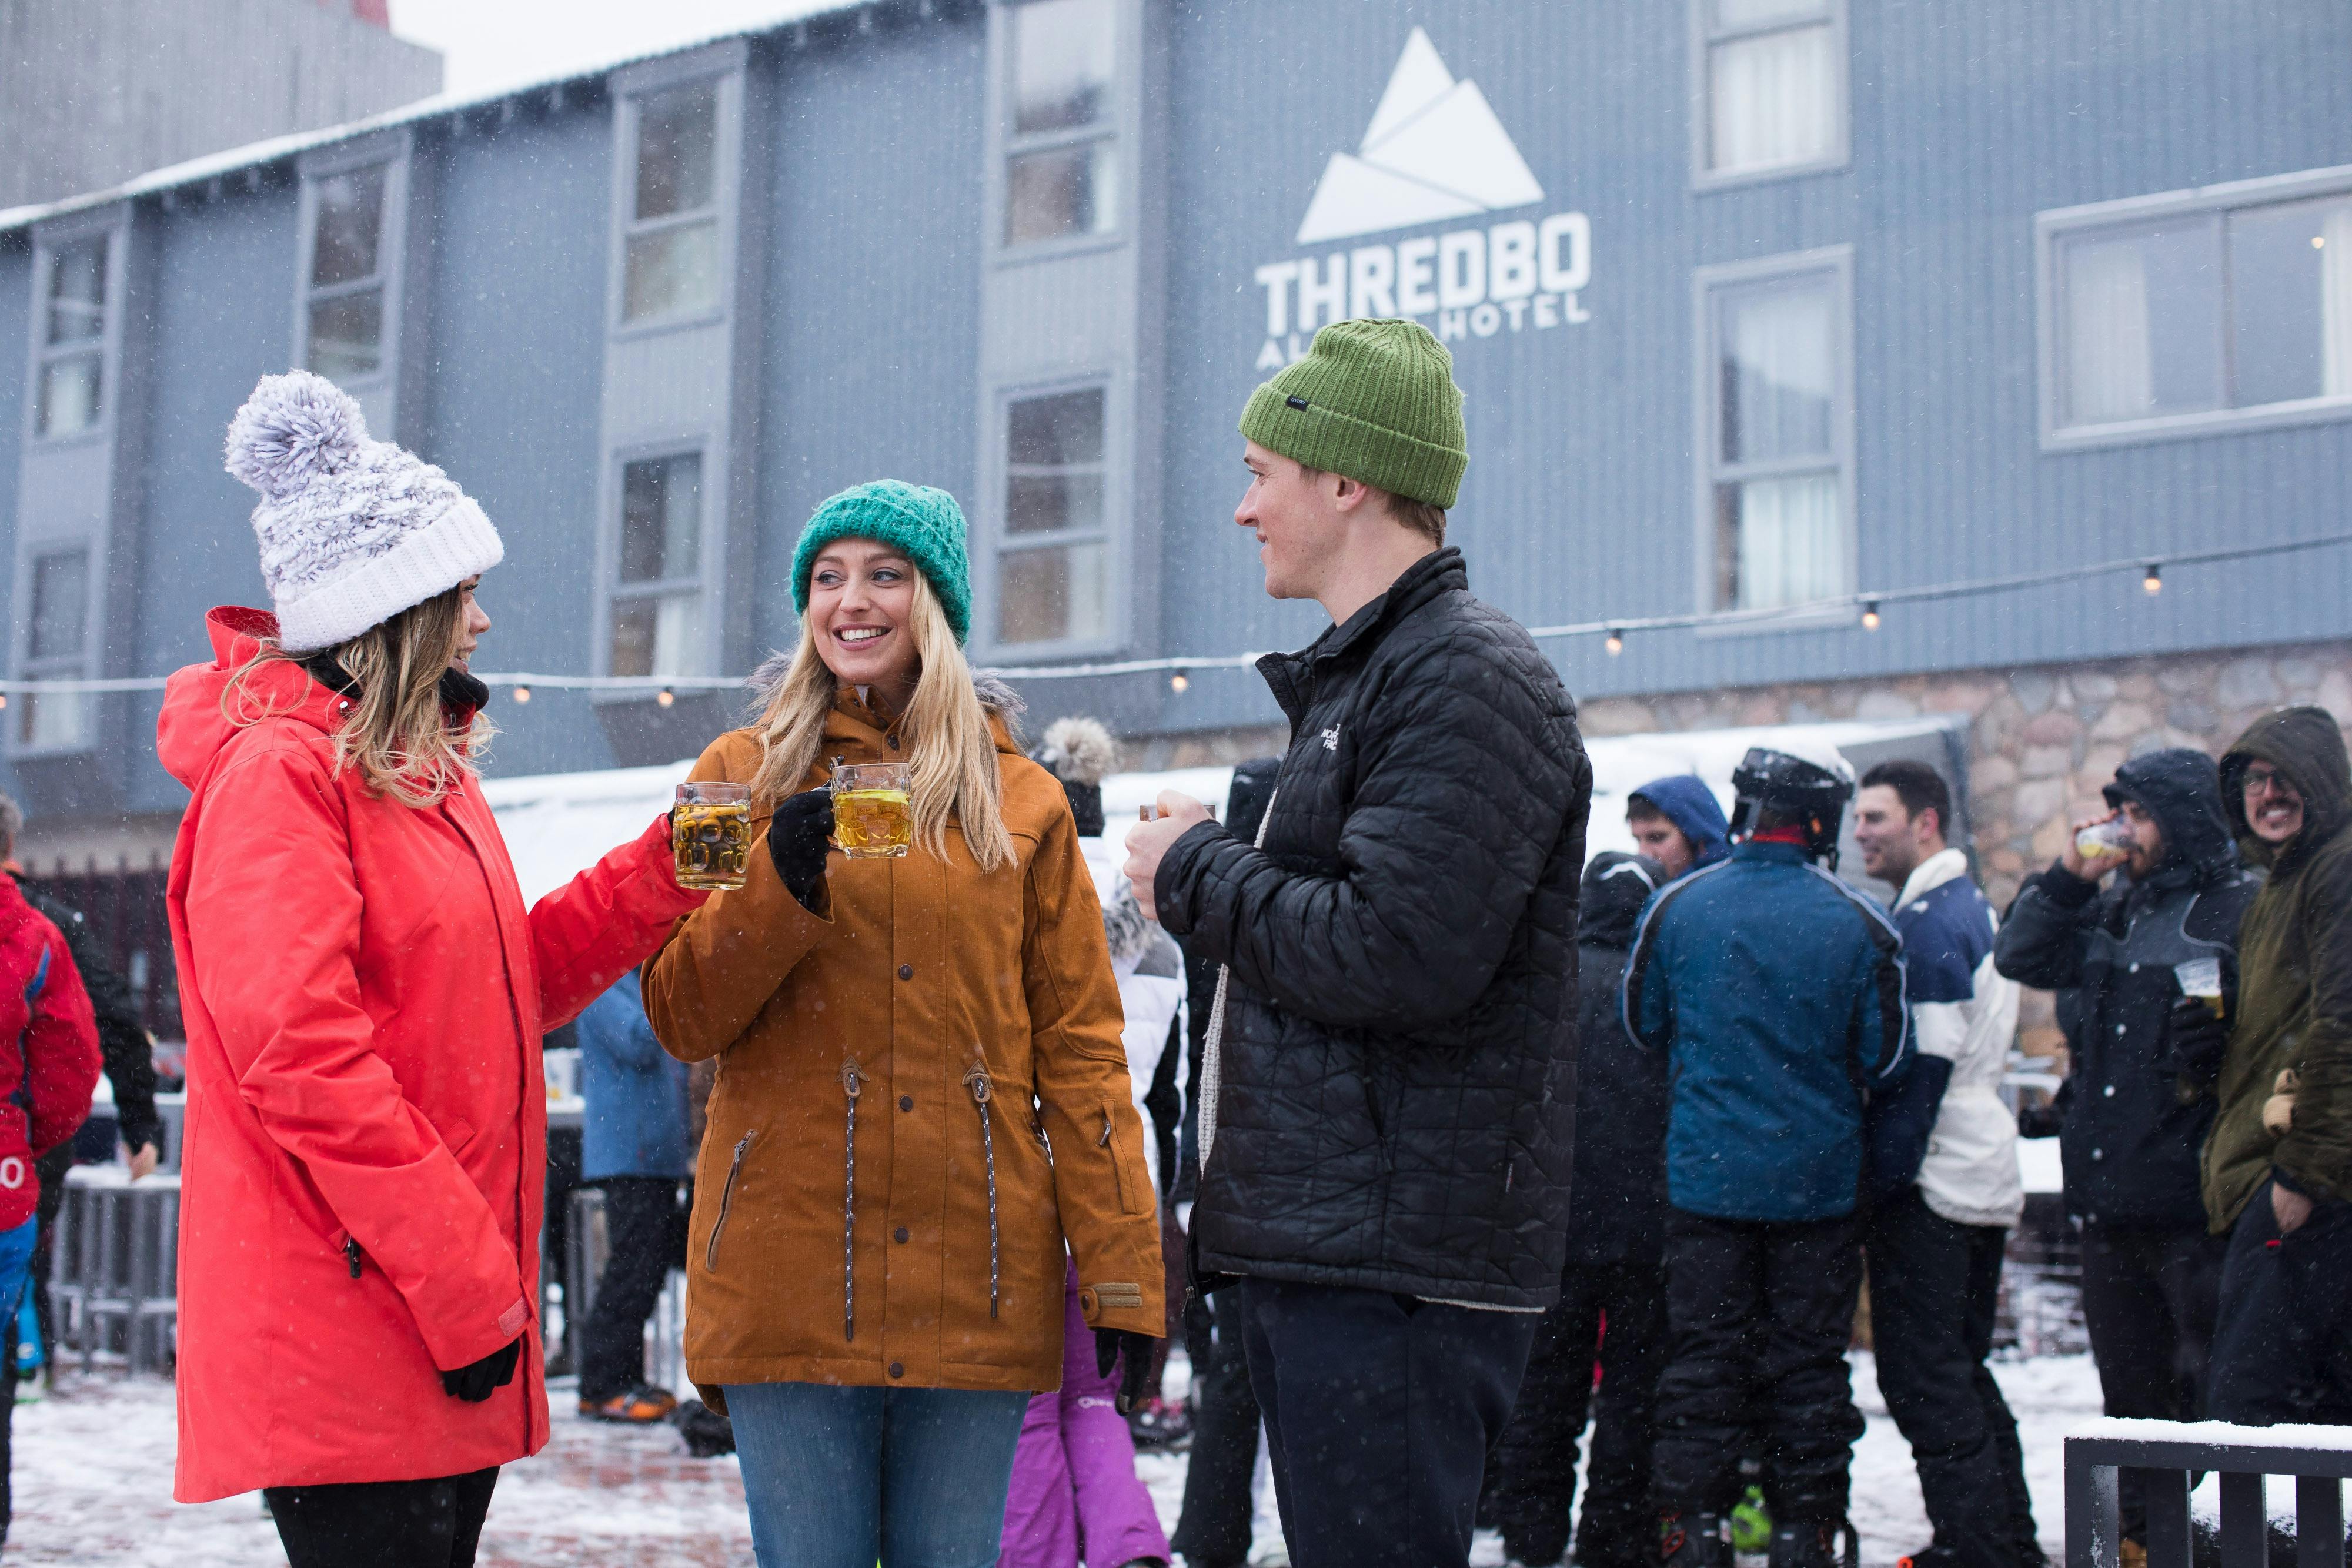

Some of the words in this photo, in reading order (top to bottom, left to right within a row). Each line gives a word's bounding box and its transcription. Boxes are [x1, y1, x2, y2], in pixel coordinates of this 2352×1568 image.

[1255, 212, 1591, 337] THREDBO
[1440, 292, 1591, 341] HOTEL
[1321, 728, 1339, 741] NOR
[1323, 738, 1338, 750] FAC
